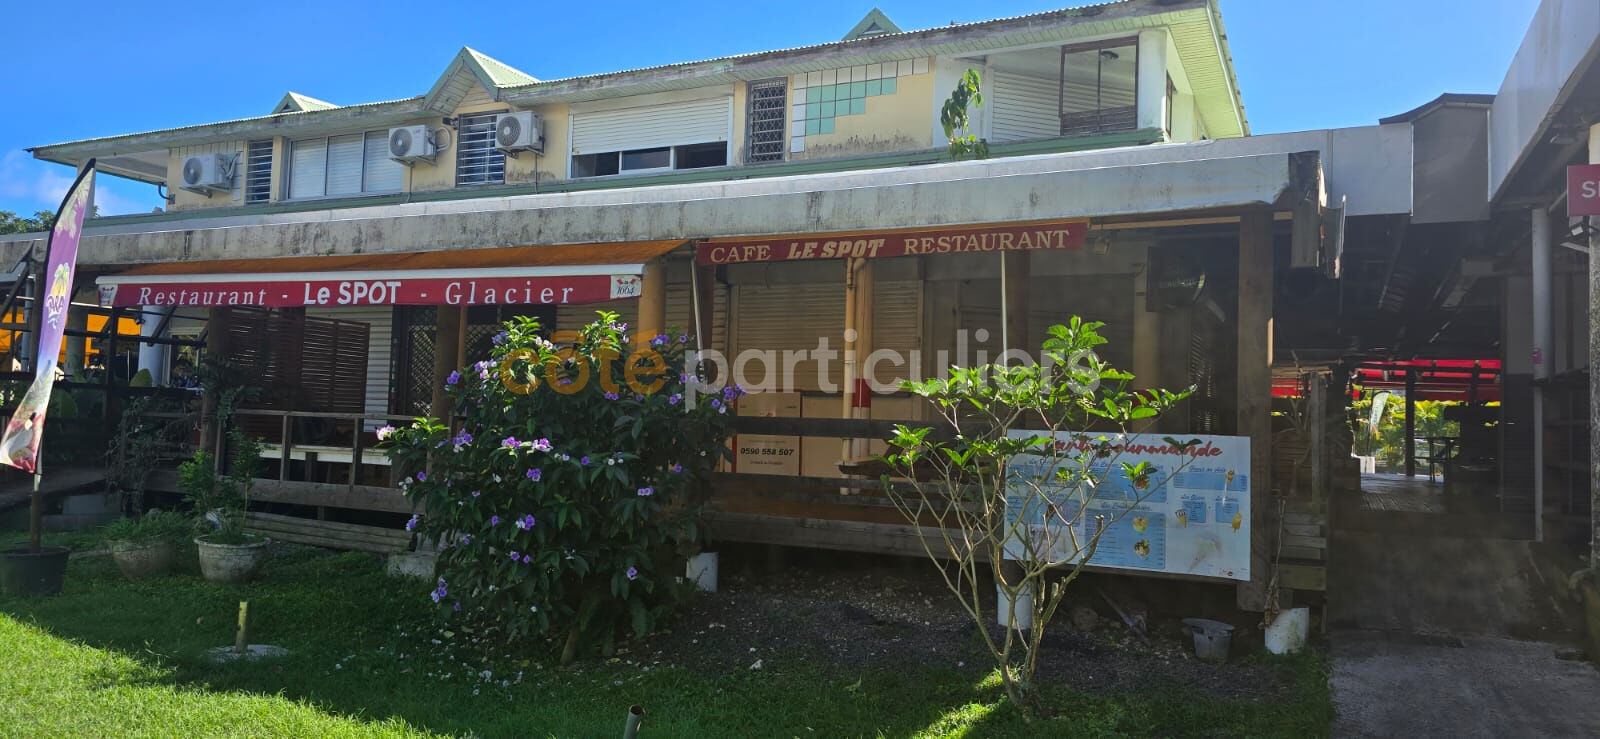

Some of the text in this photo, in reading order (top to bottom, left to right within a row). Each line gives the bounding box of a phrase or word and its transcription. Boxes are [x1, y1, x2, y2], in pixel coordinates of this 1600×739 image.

[710, 229, 1070, 262] CAFE LE SPOT RESTAURANT
[137, 287, 267, 306] Restaurant
[303, 283, 331, 305] Le
[337, 281, 401, 305] SPOT
[445, 281, 574, 305] Glacier
[740, 447, 760, 455] 0590
[778, 448, 794, 456] 507
